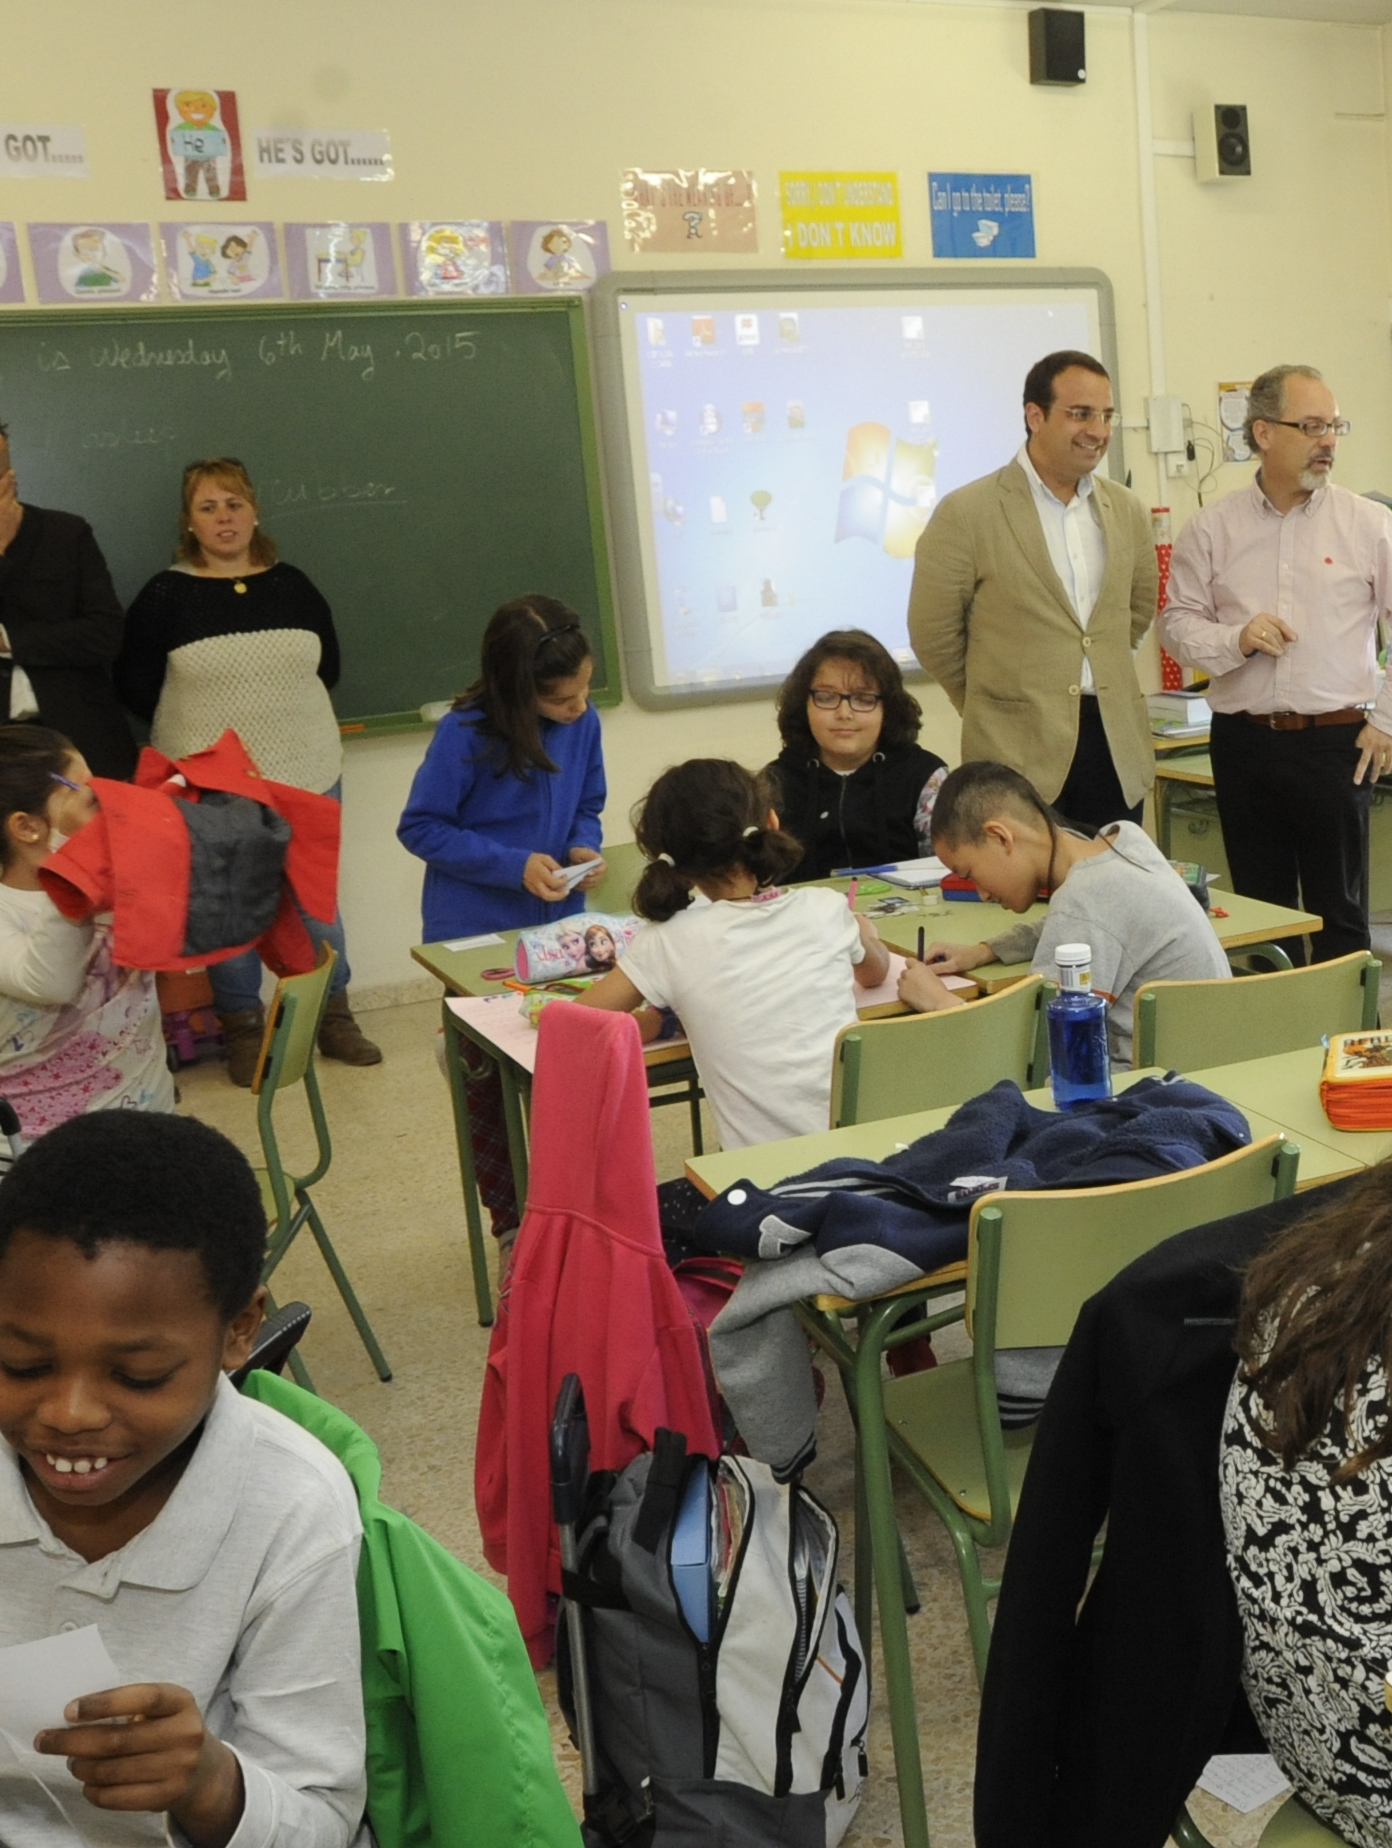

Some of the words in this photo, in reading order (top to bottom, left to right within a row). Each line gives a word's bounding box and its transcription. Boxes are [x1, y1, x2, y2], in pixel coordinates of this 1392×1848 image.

[182, 133, 206, 154] He
[257, 136, 305, 165] HE'S
[796, 221, 845, 249] DON'T
[849, 221, 897, 248] KNOW
[91, 338, 233, 382] Wednesday
[258, 330, 303, 366] 6th
[320, 329, 375, 381] May
